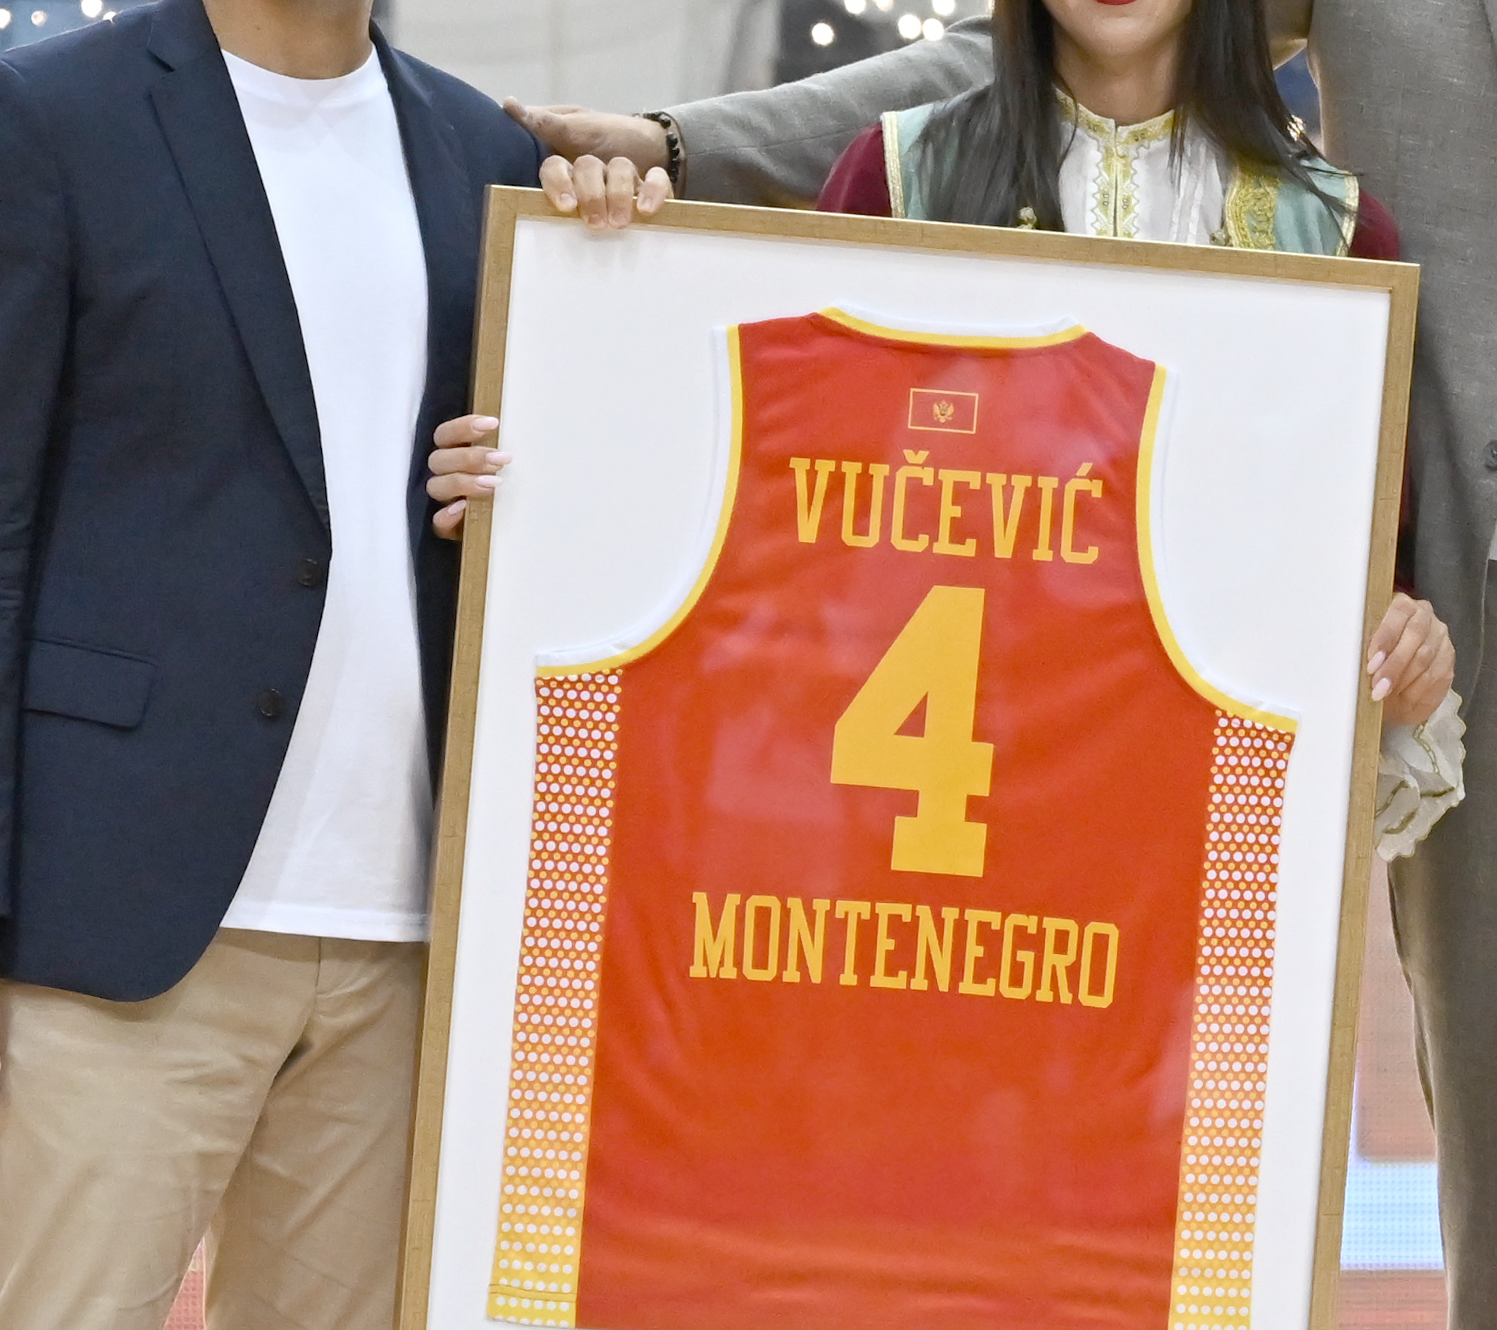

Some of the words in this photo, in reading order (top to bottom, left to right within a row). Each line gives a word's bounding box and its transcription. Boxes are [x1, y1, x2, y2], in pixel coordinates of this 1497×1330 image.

[789, 449, 1103, 565] VUČEVIĆ
[830, 585, 994, 877] 4
[689, 892, 1119, 1008] MONTENEGRO
